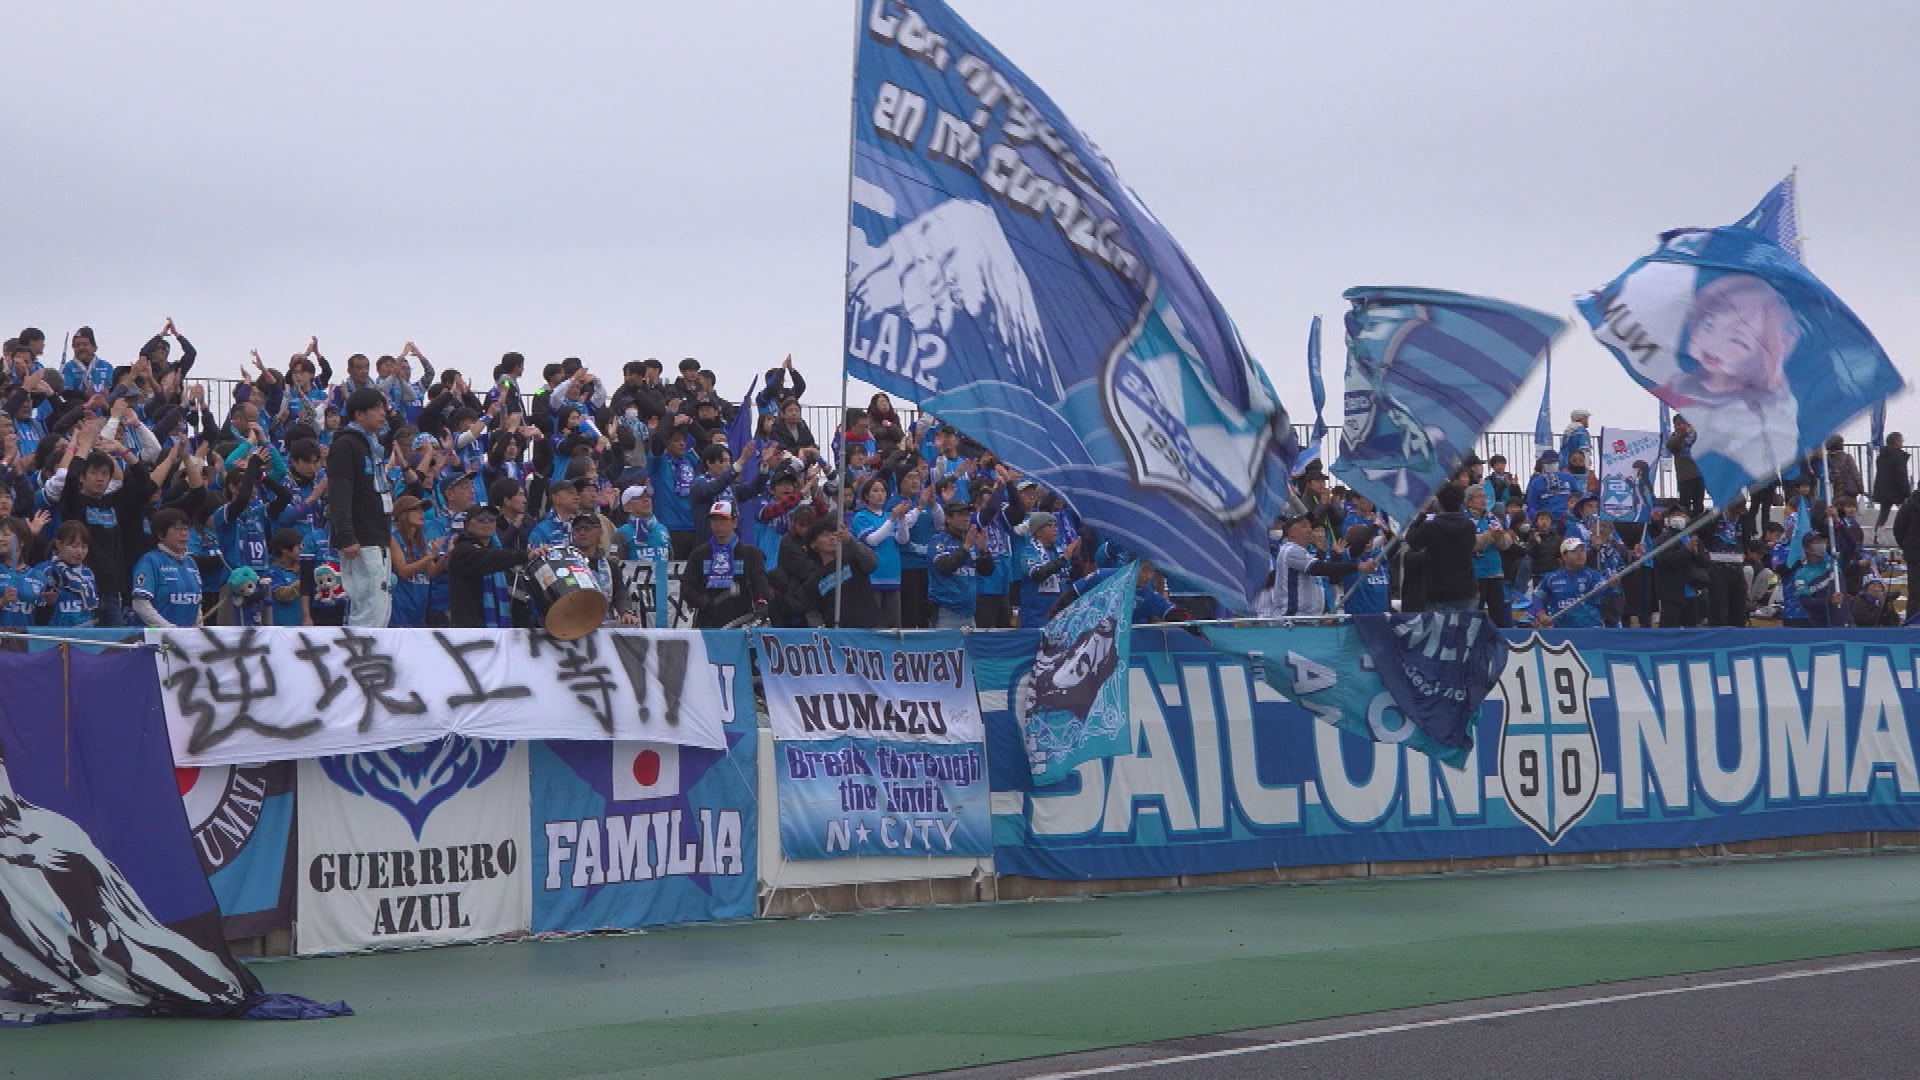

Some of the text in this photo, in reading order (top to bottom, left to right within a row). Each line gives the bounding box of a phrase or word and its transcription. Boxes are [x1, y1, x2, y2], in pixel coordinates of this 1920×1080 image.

[872, 80, 926, 150] en
[250, 541, 264, 559] 19
[762, 633, 837, 677] Don't
[892, 649, 966, 690] away
[795, 692, 948, 735] NUMAZU
[1607, 652, 1920, 811] NUMA
[785, 743, 982, 788] Break through
[193, 761, 268, 867] UMAZ
[838, 779, 949, 813] the limit
[544, 808, 745, 891] FAMILIA
[879, 816, 959, 852] CITY
[308, 840, 518, 894] GUERRERO
[371, 892, 471, 936] AZUL
